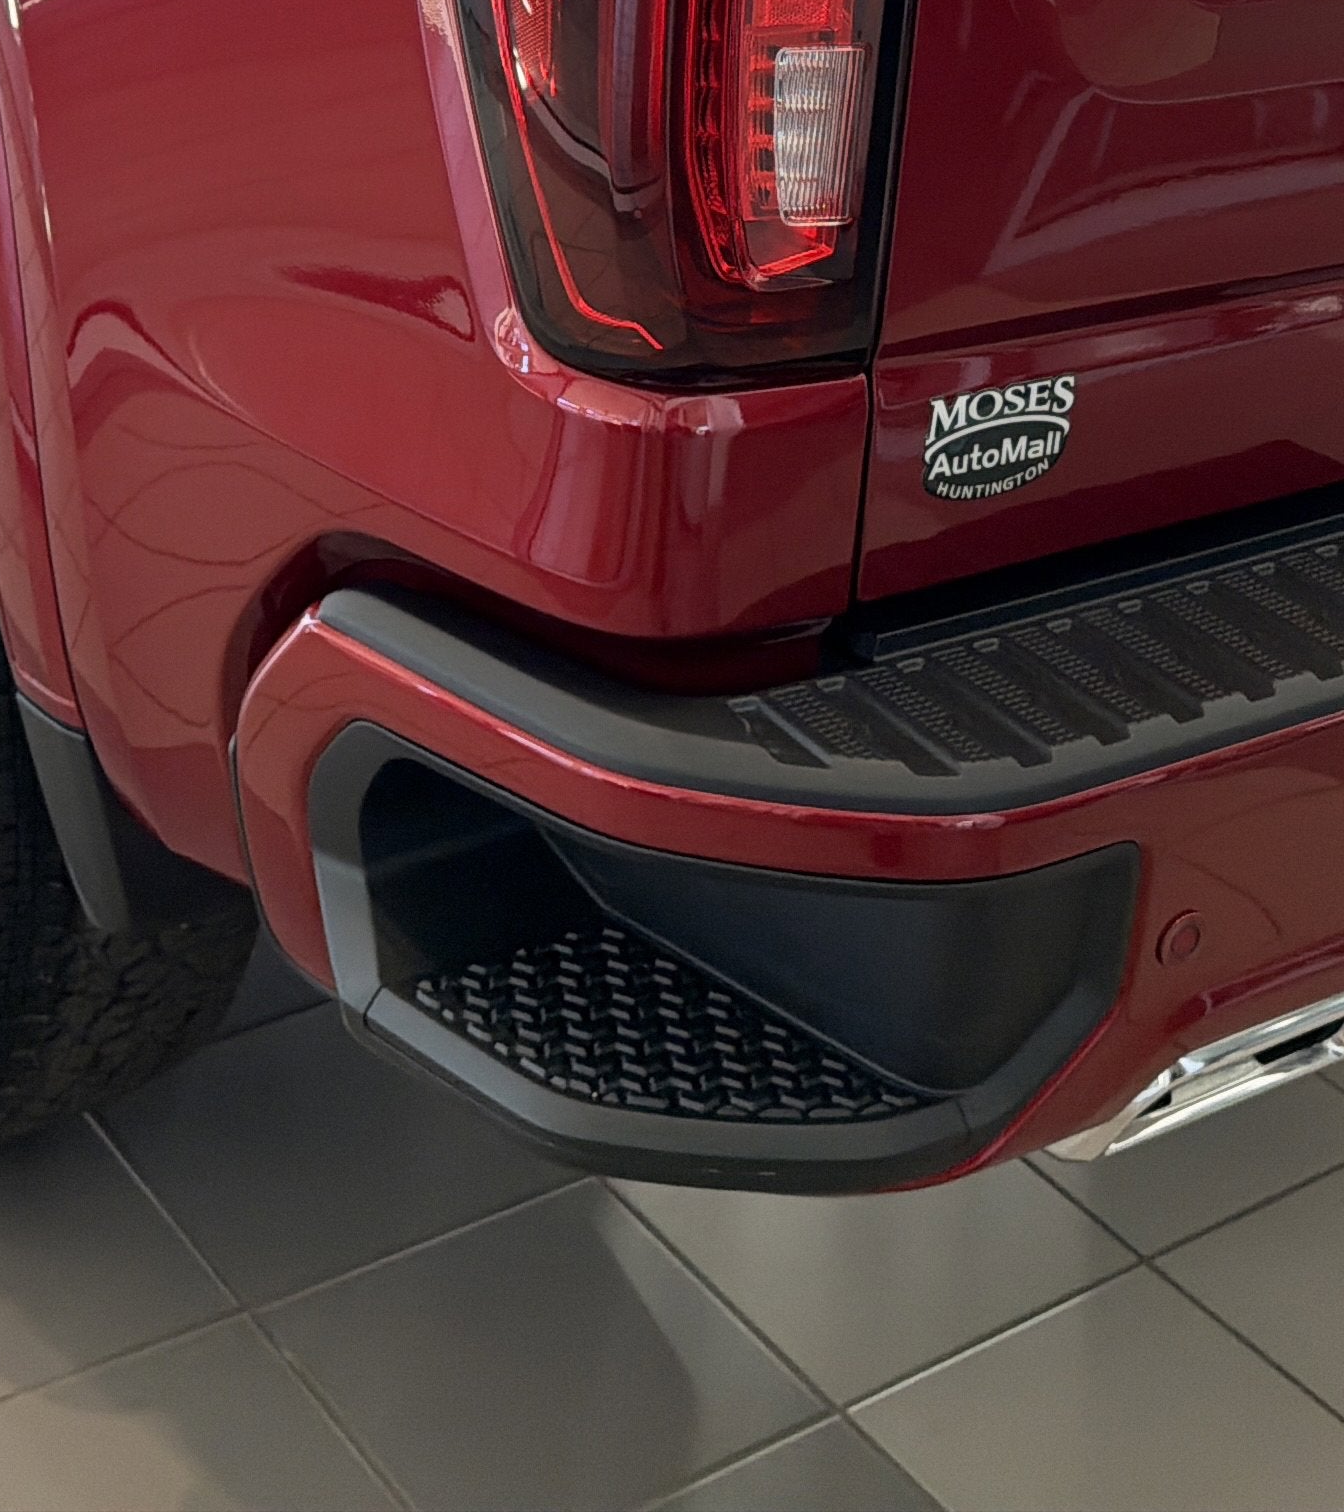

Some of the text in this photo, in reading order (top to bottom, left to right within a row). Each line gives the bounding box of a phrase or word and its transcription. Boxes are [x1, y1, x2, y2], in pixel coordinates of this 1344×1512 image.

[925, 375, 1075, 446] MOSES
[927, 430, 1061, 481] AutoMall
[936, 458, 1050, 500] HUNTINGTON
